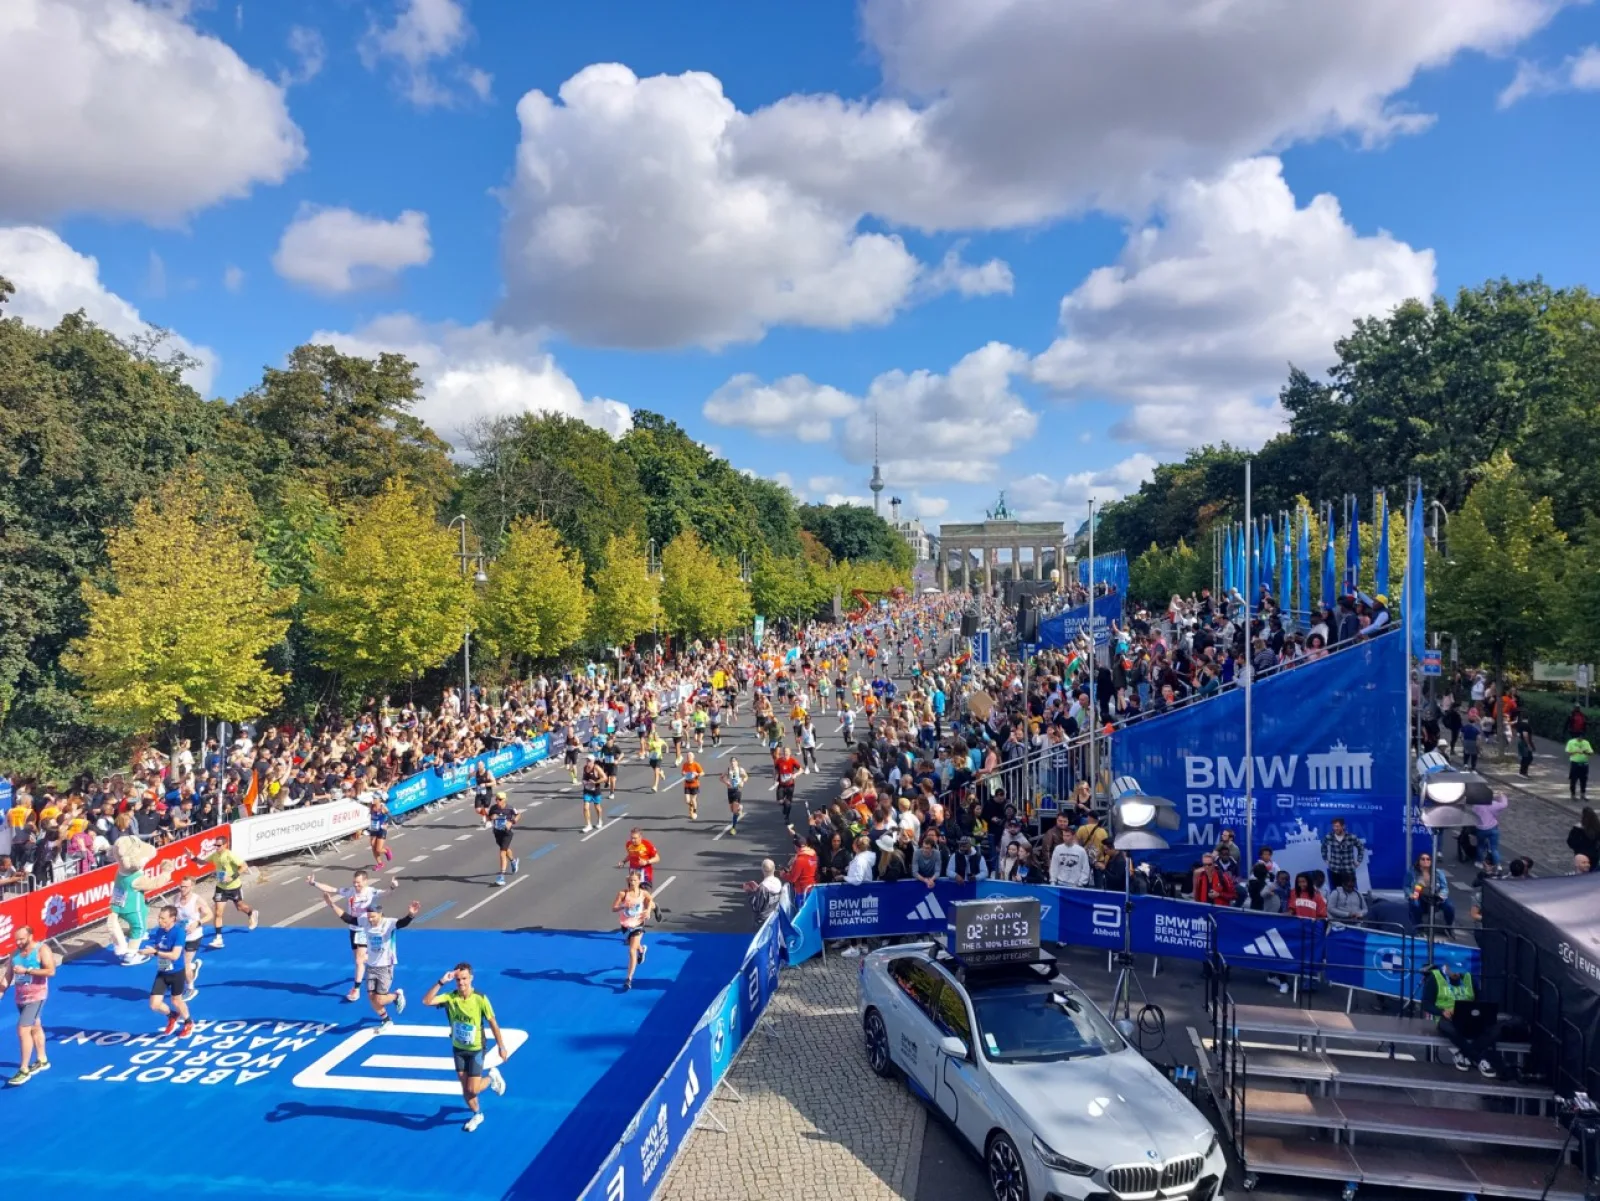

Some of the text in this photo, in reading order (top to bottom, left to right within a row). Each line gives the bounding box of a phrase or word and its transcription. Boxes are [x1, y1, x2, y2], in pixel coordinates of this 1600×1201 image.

[1185, 754, 1298, 788] BMW
[256, 809, 360, 840] SPORTMETROPOLE BERLIN
[829, 899, 860, 910] BMW
[829, 909, 860, 918] BERLIN
[829, 916, 879, 926] MARATHON
[1155, 914, 1190, 928] BMW
[1093, 927, 1120, 938] Abbott
[1155, 926, 1190, 938] BERLIN
[1155, 934, 1211, 949] MARATHON
[59, 1030, 318, 1052] MARATHON
[129, 1050, 288, 1069] WORLD
[78, 1065, 270, 1086] ABBOTT
